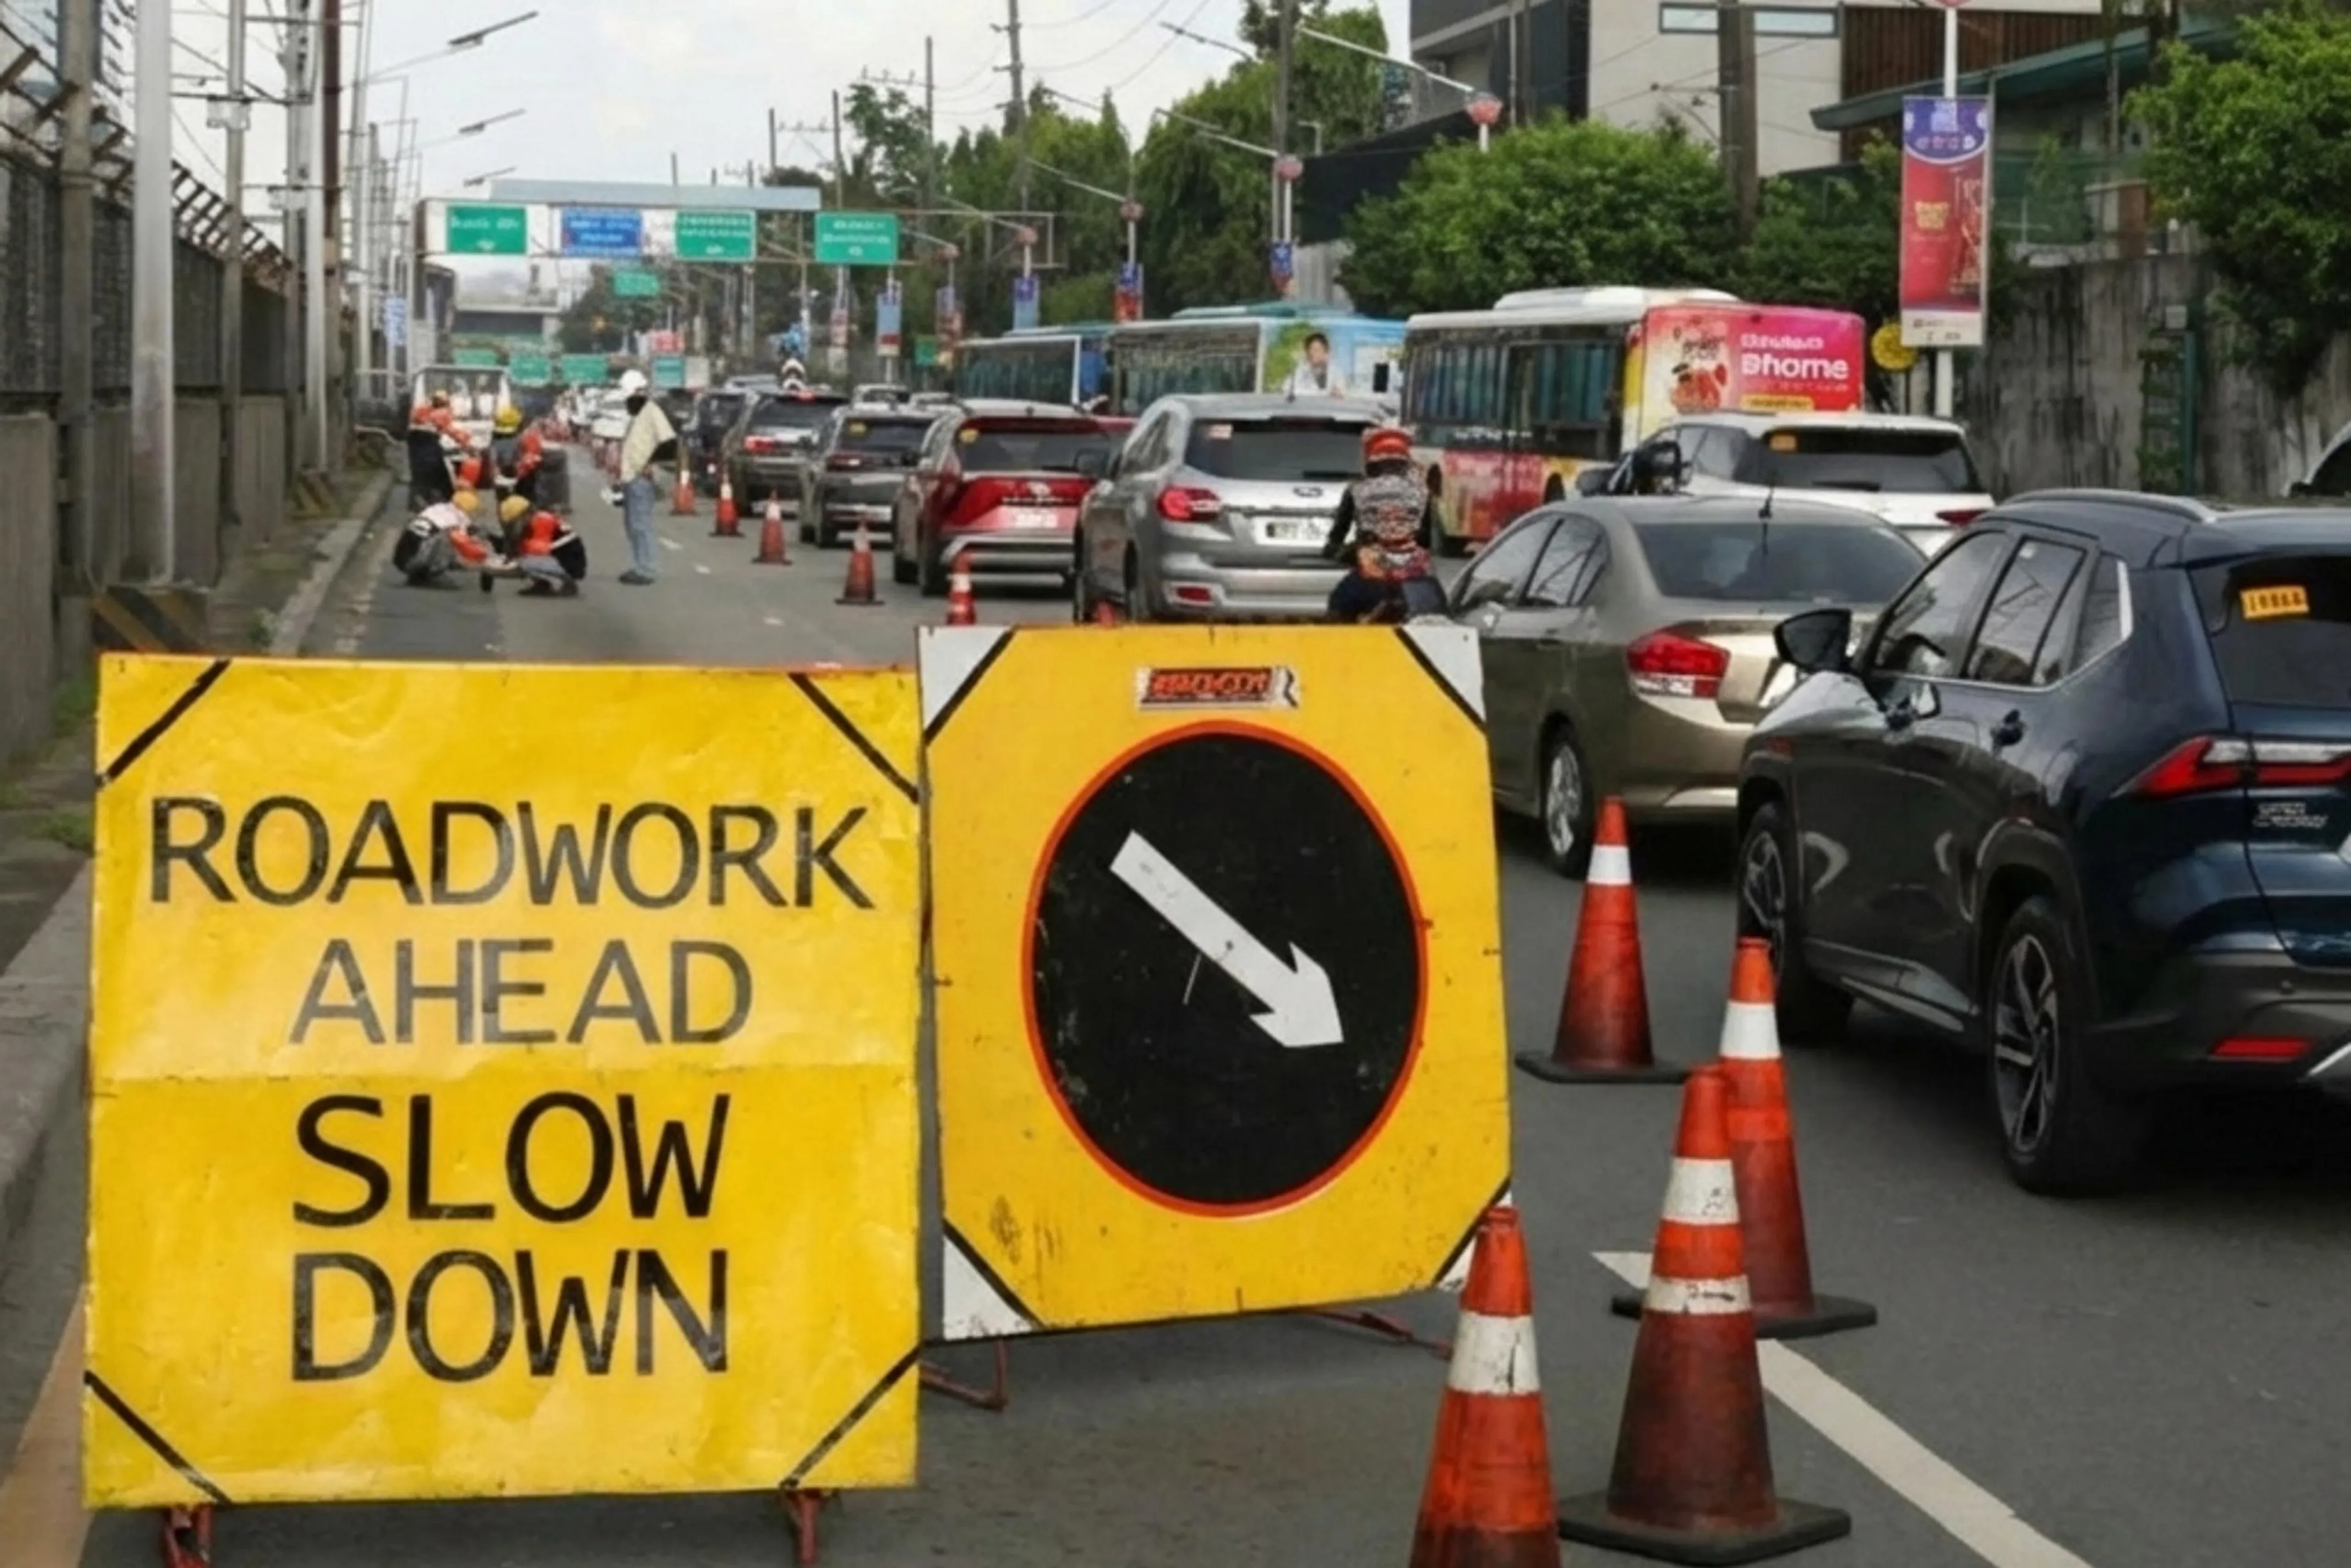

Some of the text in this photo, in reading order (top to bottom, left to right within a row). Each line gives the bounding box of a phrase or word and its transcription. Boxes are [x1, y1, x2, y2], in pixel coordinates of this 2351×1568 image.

[151, 795, 876, 909] ROADWORK
[289, 938, 752, 1045] AHEAD
[293, 1091, 730, 1227] SLOW
[291, 1248, 727, 1382] DOWN
